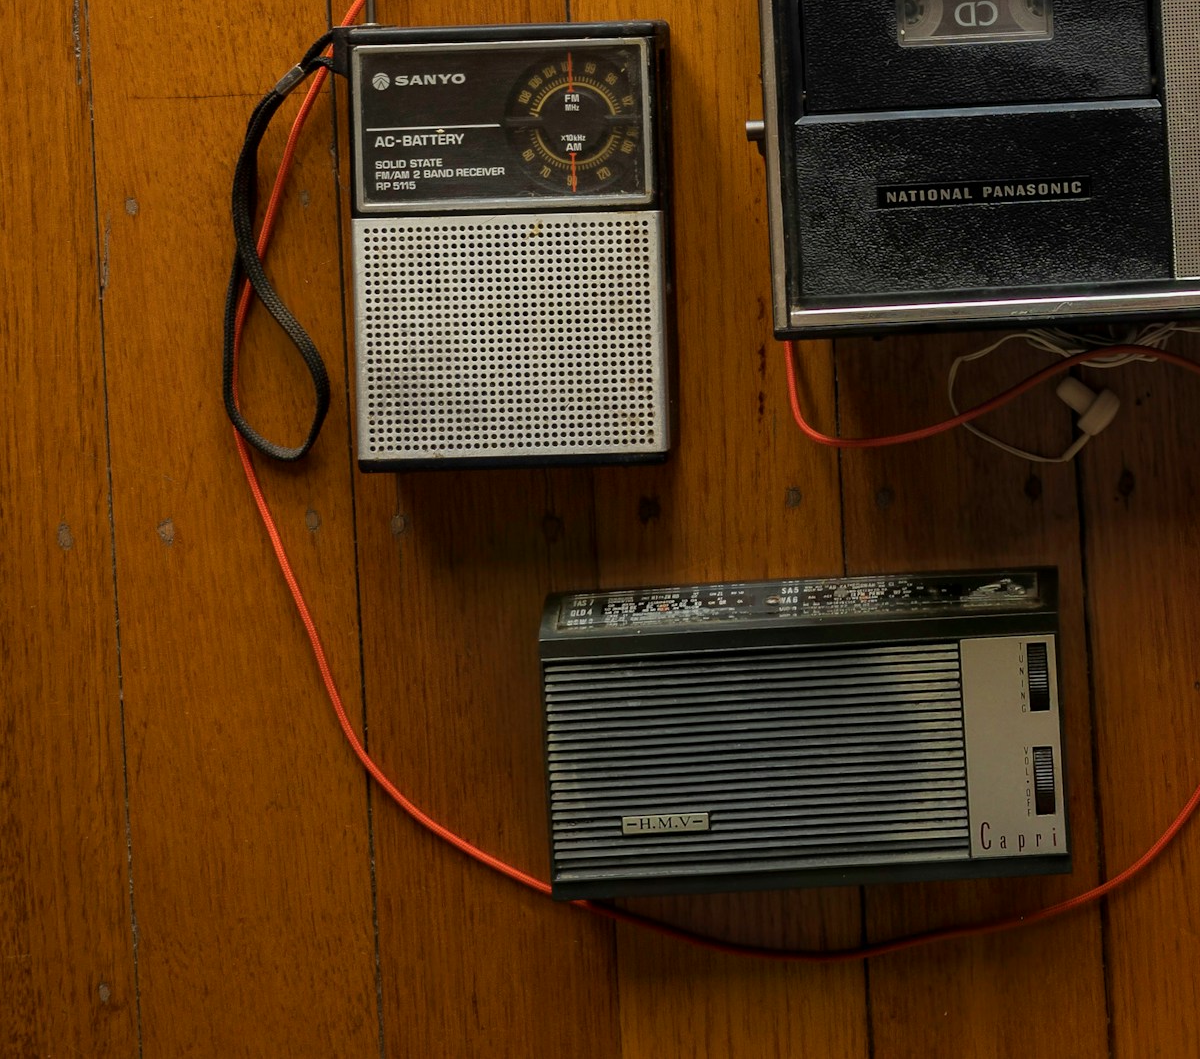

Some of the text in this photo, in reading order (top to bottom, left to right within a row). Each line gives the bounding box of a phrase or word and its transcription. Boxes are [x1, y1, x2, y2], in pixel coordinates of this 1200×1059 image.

[954, 1, 998, 26] CD
[584, 61, 596, 74] 99
[395, 73, 466, 86] SANYO
[518, 90, 533, 104] 108
[565, 94, 580, 102] FM
[375, 133, 465, 148] AC-BATTERY
[566, 143, 582, 151] AM
[522, 150, 535, 163] 60
[375, 158, 443, 170] SOLID STATE
[375, 167, 505, 180] FM/AM 2 BAND RECEIVER
[540, 166, 551, 179] 70
[597, 166, 611, 181] 120
[376, 181, 416, 191] RP 5115
[886, 180, 1082, 204] NATIONAL PANASONIC
[981, 822, 1057, 852] Capri
